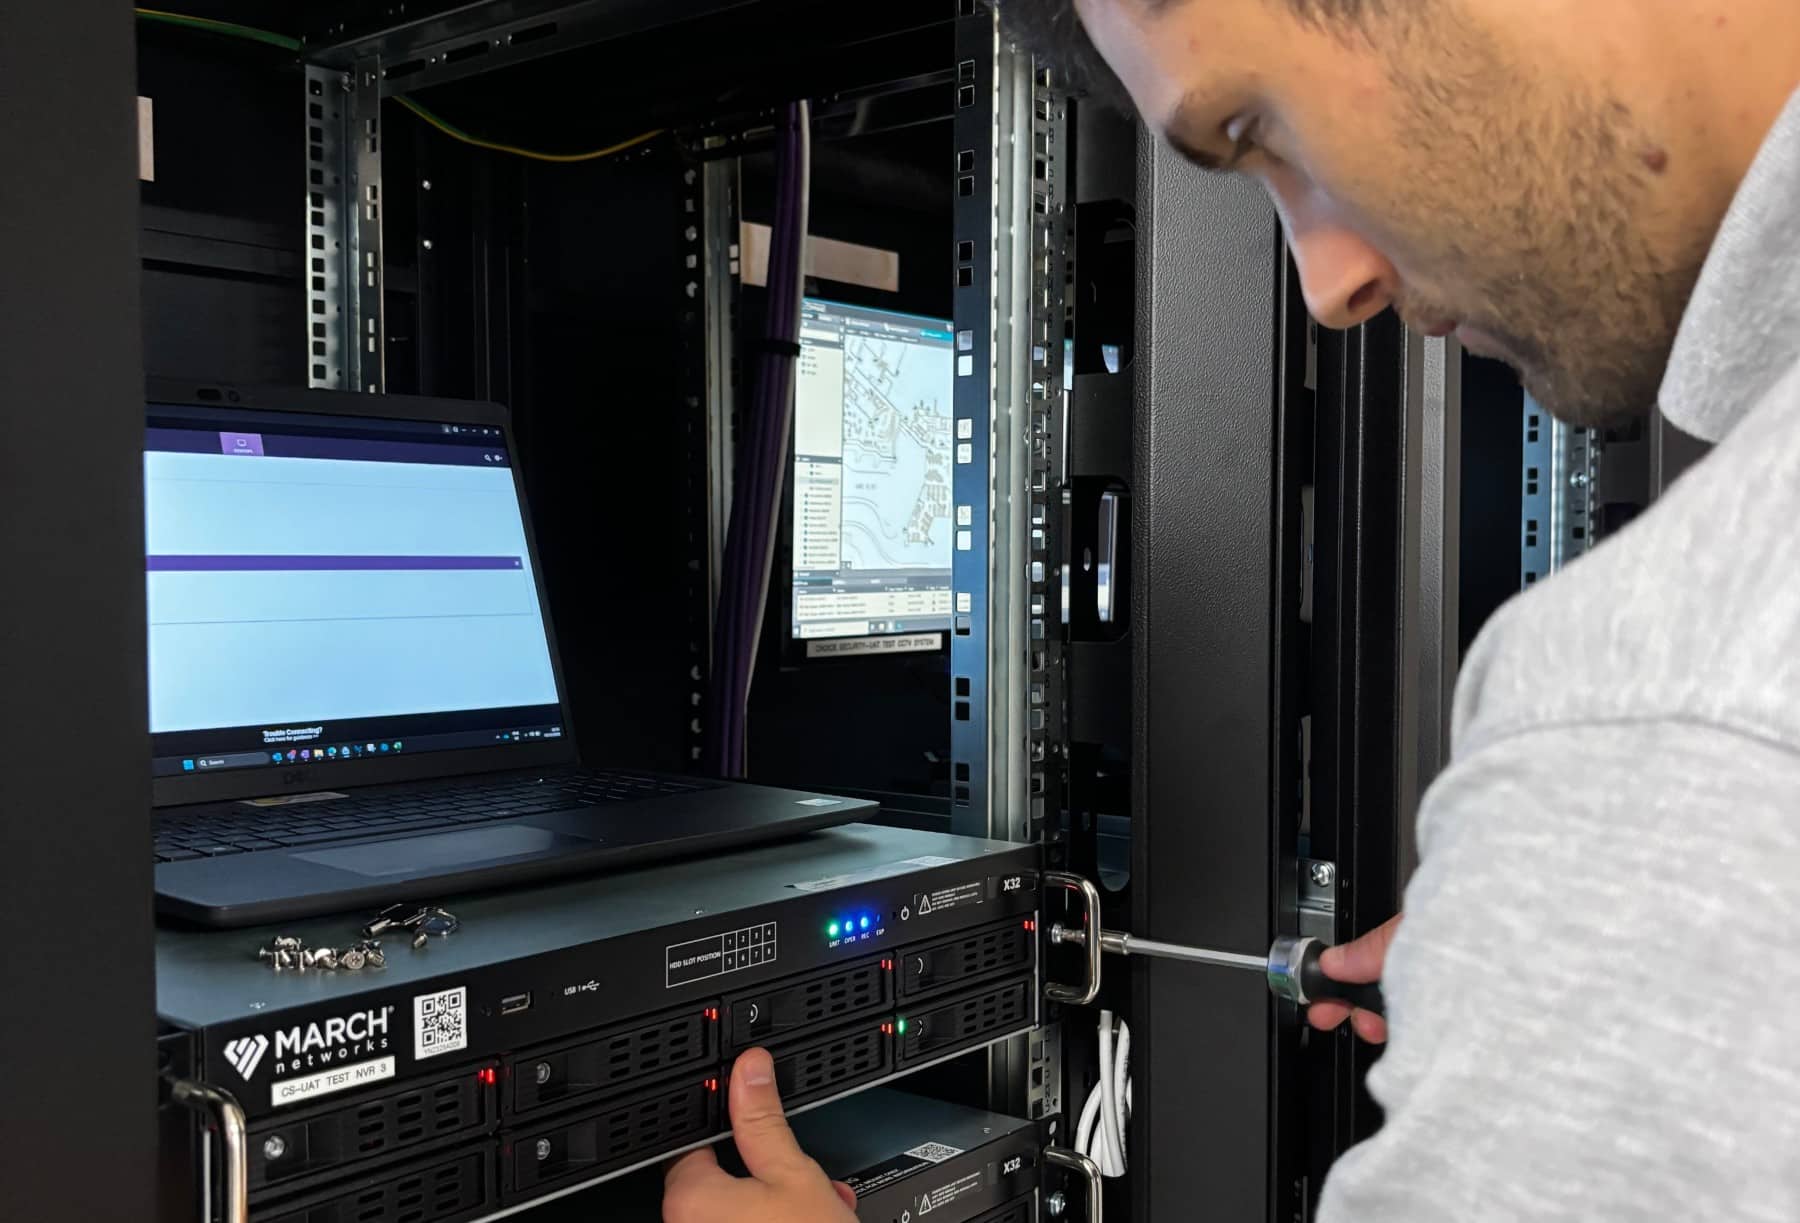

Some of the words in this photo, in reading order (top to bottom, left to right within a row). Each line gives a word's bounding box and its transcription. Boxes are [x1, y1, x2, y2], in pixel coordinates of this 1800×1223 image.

[882, 639, 896, 647] TEST
[897, 639, 912, 648] CCTV
[914, 638, 934, 647] SYSTEM
[262, 729, 286, 737] Trouble
[1003, 877, 1021, 891] X32
[669, 959, 682, 969] HDD
[683, 956, 696, 967] SLOT
[697, 951, 721, 963] POSITION
[564, 985, 577, 995] USB
[275, 1007, 389, 1059] MARCH
[276, 1037, 389, 1074] networks
[281, 1079, 321, 1097] CS-UAT
[326, 1072, 350, 1091] TEST
[356, 1065, 376, 1084] NVR
[379, 1063, 387, 1074] 3
[1003, 1156, 1021, 1174] X32
